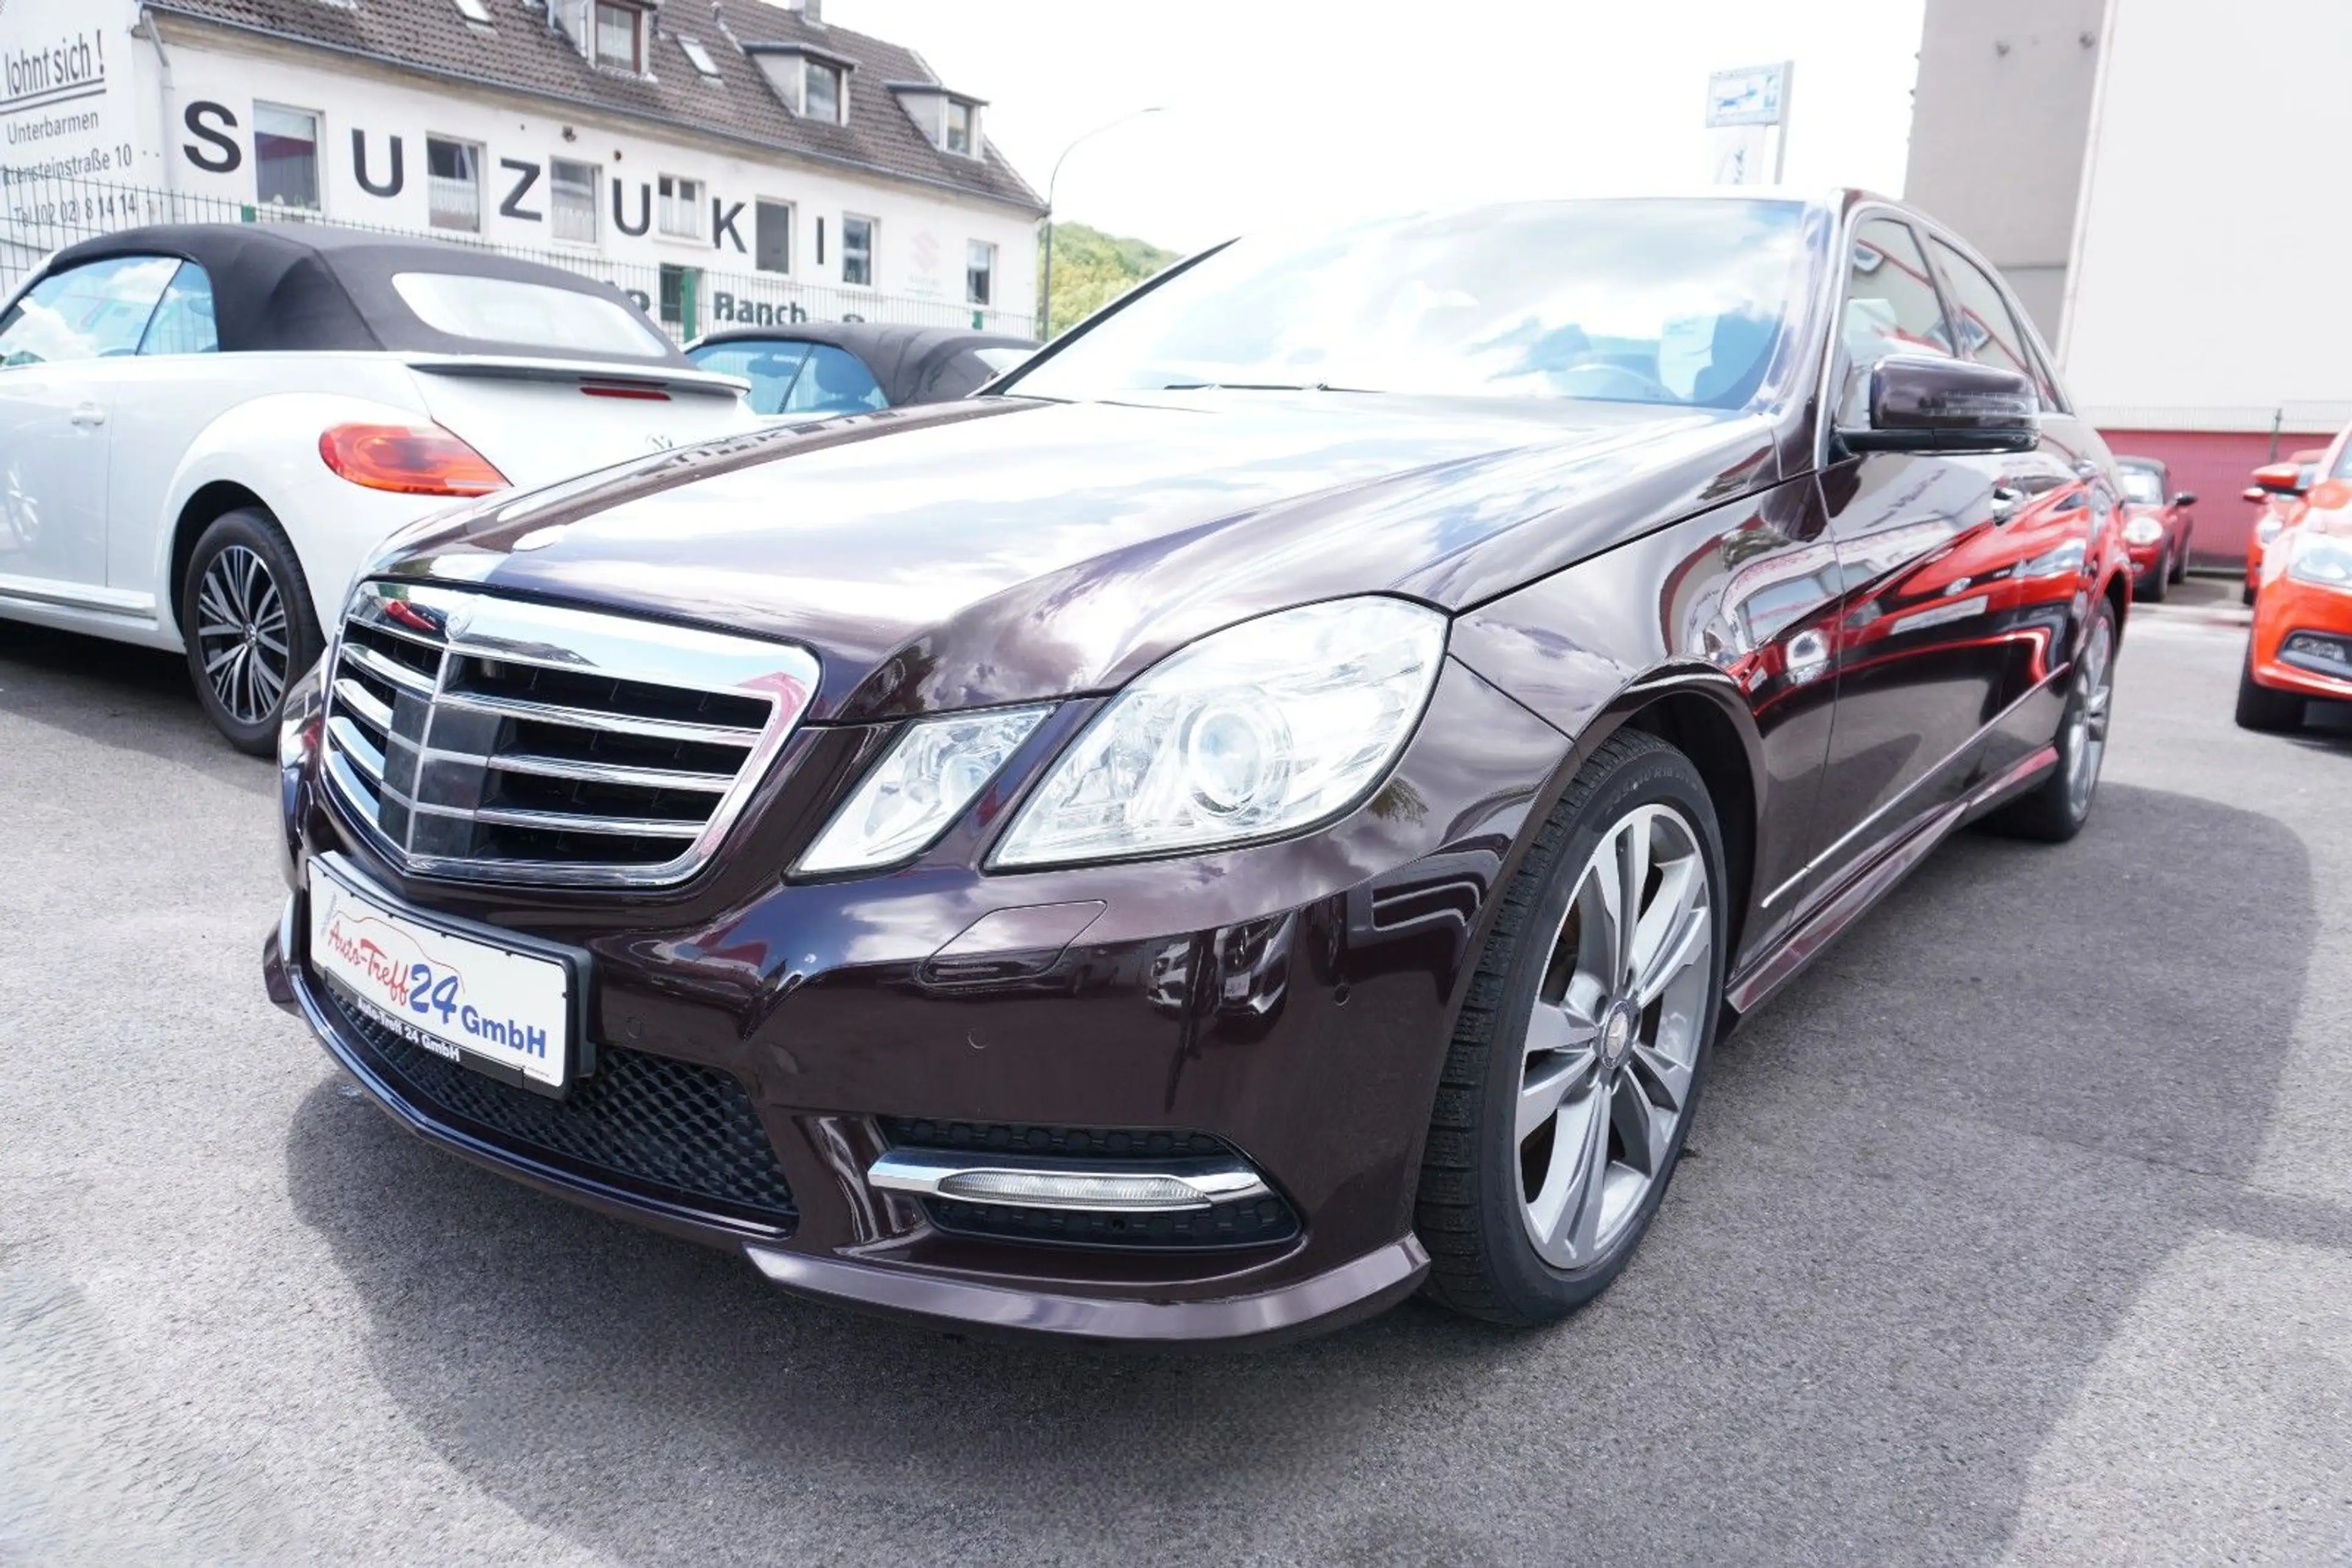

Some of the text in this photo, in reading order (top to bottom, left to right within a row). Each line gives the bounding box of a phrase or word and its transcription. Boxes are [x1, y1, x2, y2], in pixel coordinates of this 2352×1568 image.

[6, 47, 49, 96] lohnt
[8, 111, 99, 145] Unterbarmen
[116, 143, 132, 167] 10
[714, 291, 806, 327] Ranch
[405, 1025, 418, 1044] 24
[421, 1034, 460, 1062] GmbH
[461, 1005, 546, 1058] GmbH
